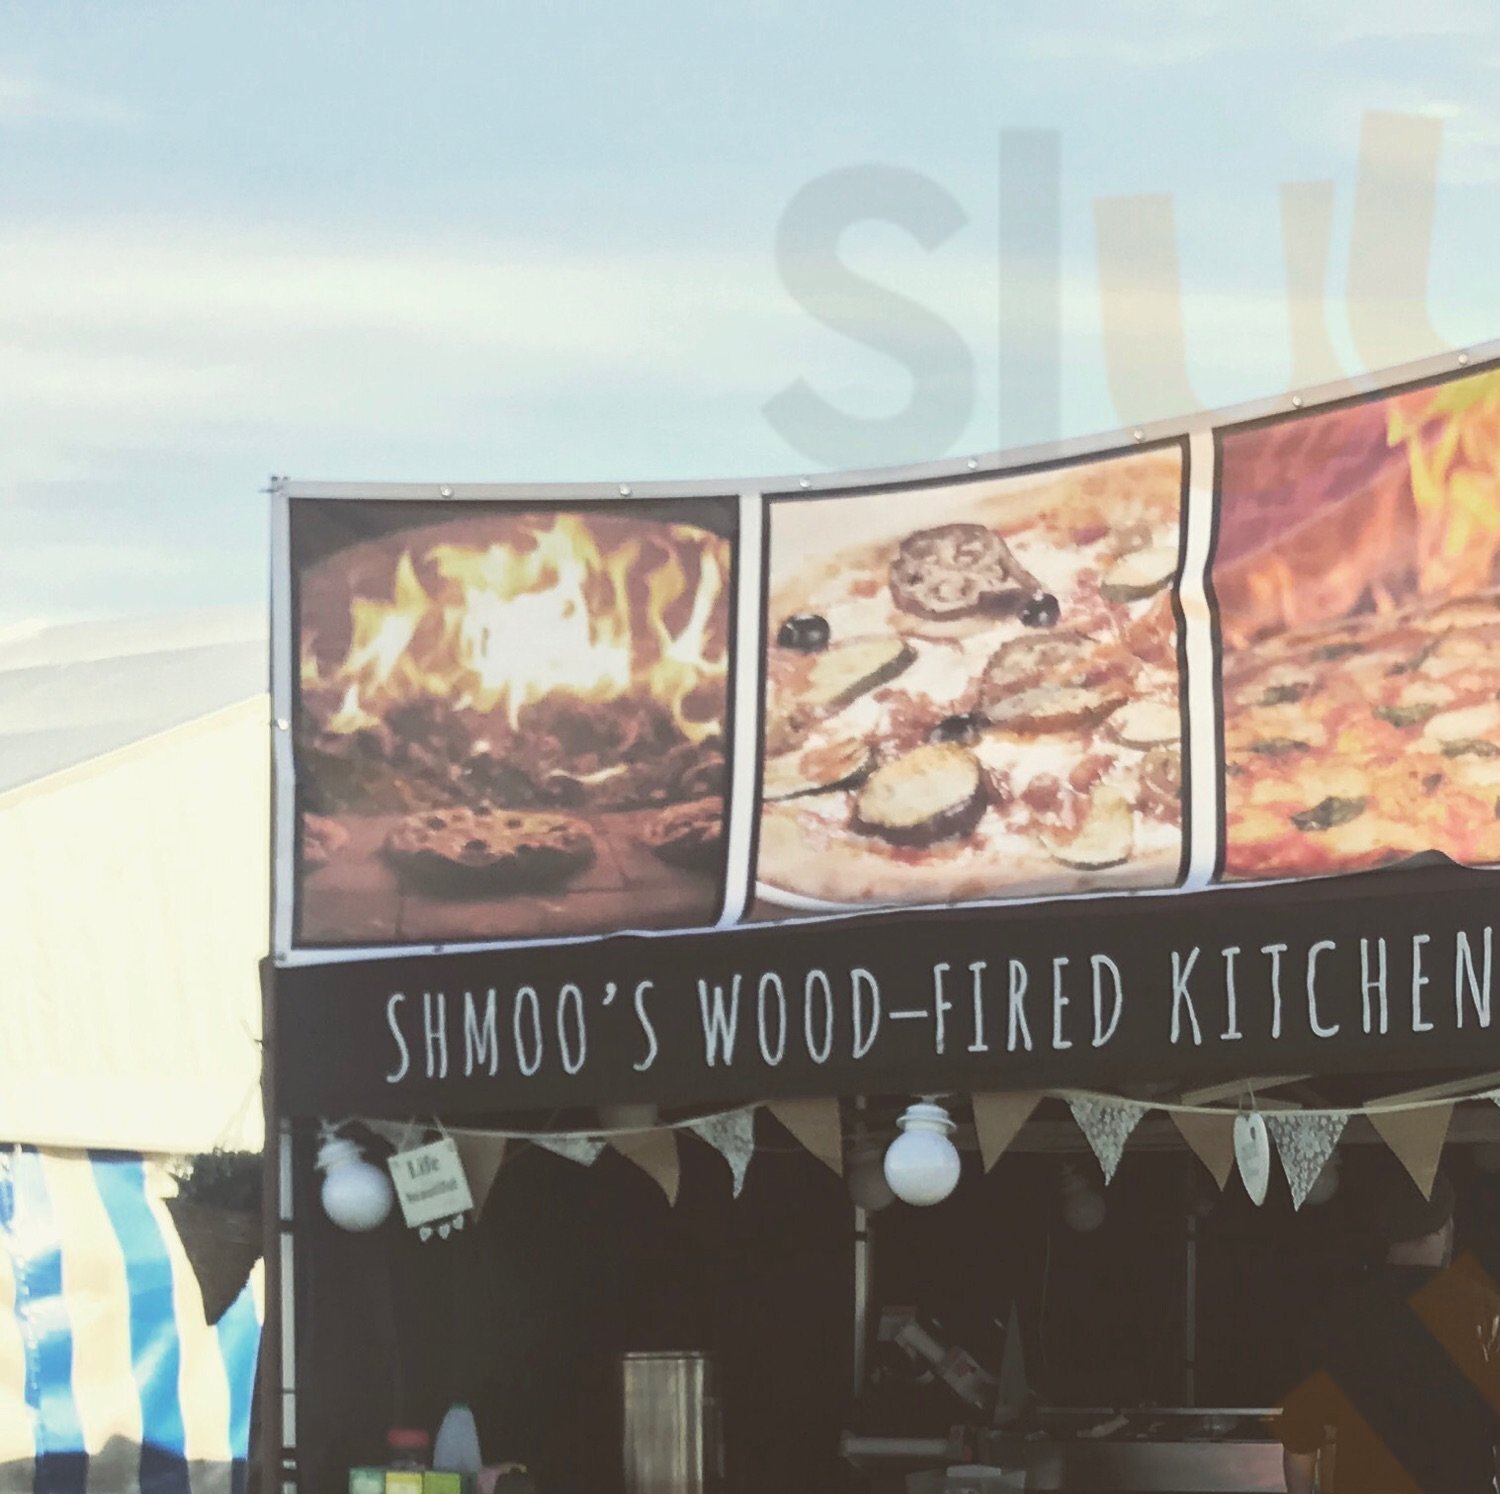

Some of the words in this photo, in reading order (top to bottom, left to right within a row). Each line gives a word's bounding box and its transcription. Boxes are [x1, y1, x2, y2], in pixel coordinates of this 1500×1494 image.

[387, 980, 657, 1083] SHMOO'S
[698, 954, 1122, 1066] WOOD-FIRED
[1171, 926, 1492, 1045] KITCHEN
